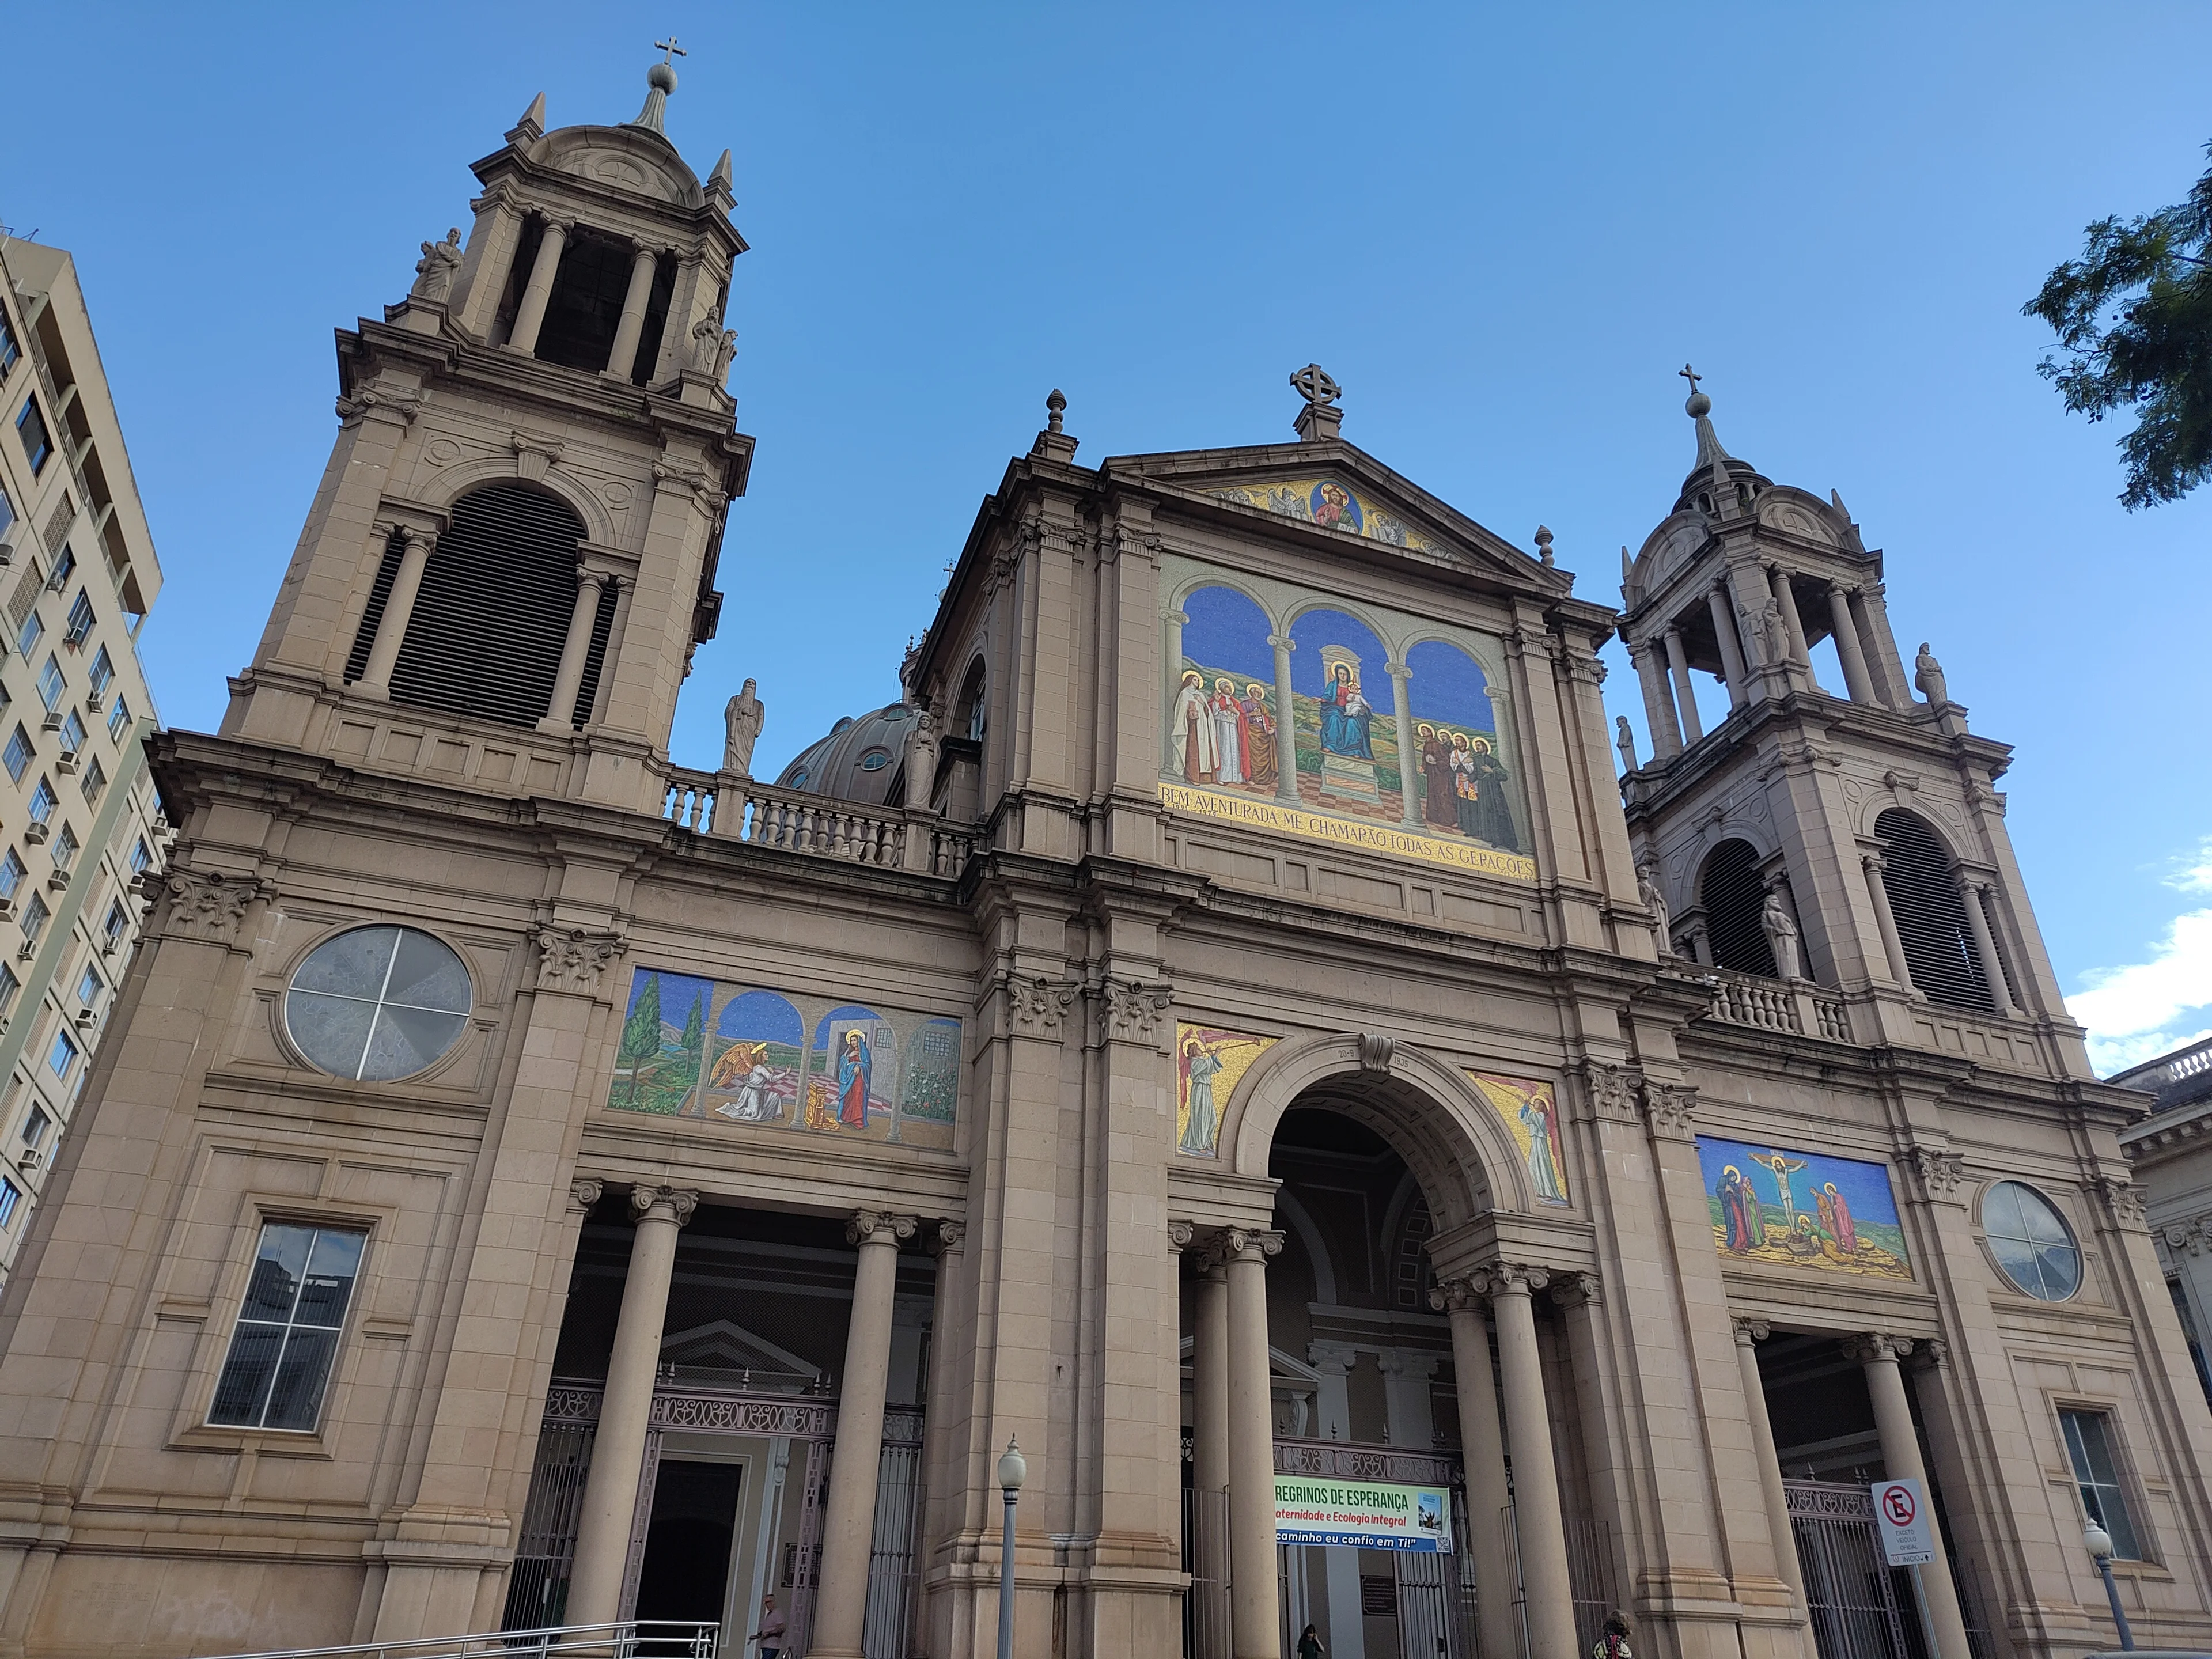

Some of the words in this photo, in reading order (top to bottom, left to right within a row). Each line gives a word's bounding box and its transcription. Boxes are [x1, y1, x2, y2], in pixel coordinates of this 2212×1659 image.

[1283, 811, 1304, 830] ME
[1310, 819, 1386, 846] CHAMARÃO
[1389, 834, 1431, 855] TODAS
[1437, 845, 1454, 860] AS
[1459, 849, 1533, 876] GERAÇÕES
[1338, 1049, 1355, 1058] 20-9
[1394, 1056, 1410, 1068] 1935
[1331, 1488, 1344, 1505] DE
[1347, 1490, 1408, 1512] ESPERANÇA
[1326, 1513, 1331, 1521] e
[1333, 1512, 1369, 1525] Ecologia
[1371, 1514, 1406, 1528] Integral
[1275, 1531, 1322, 1542] caminho
[1325, 1535, 1338, 1543] eu
[1342, 1535, 1374, 1545] confio
[1377, 1539, 1393, 1547] em
